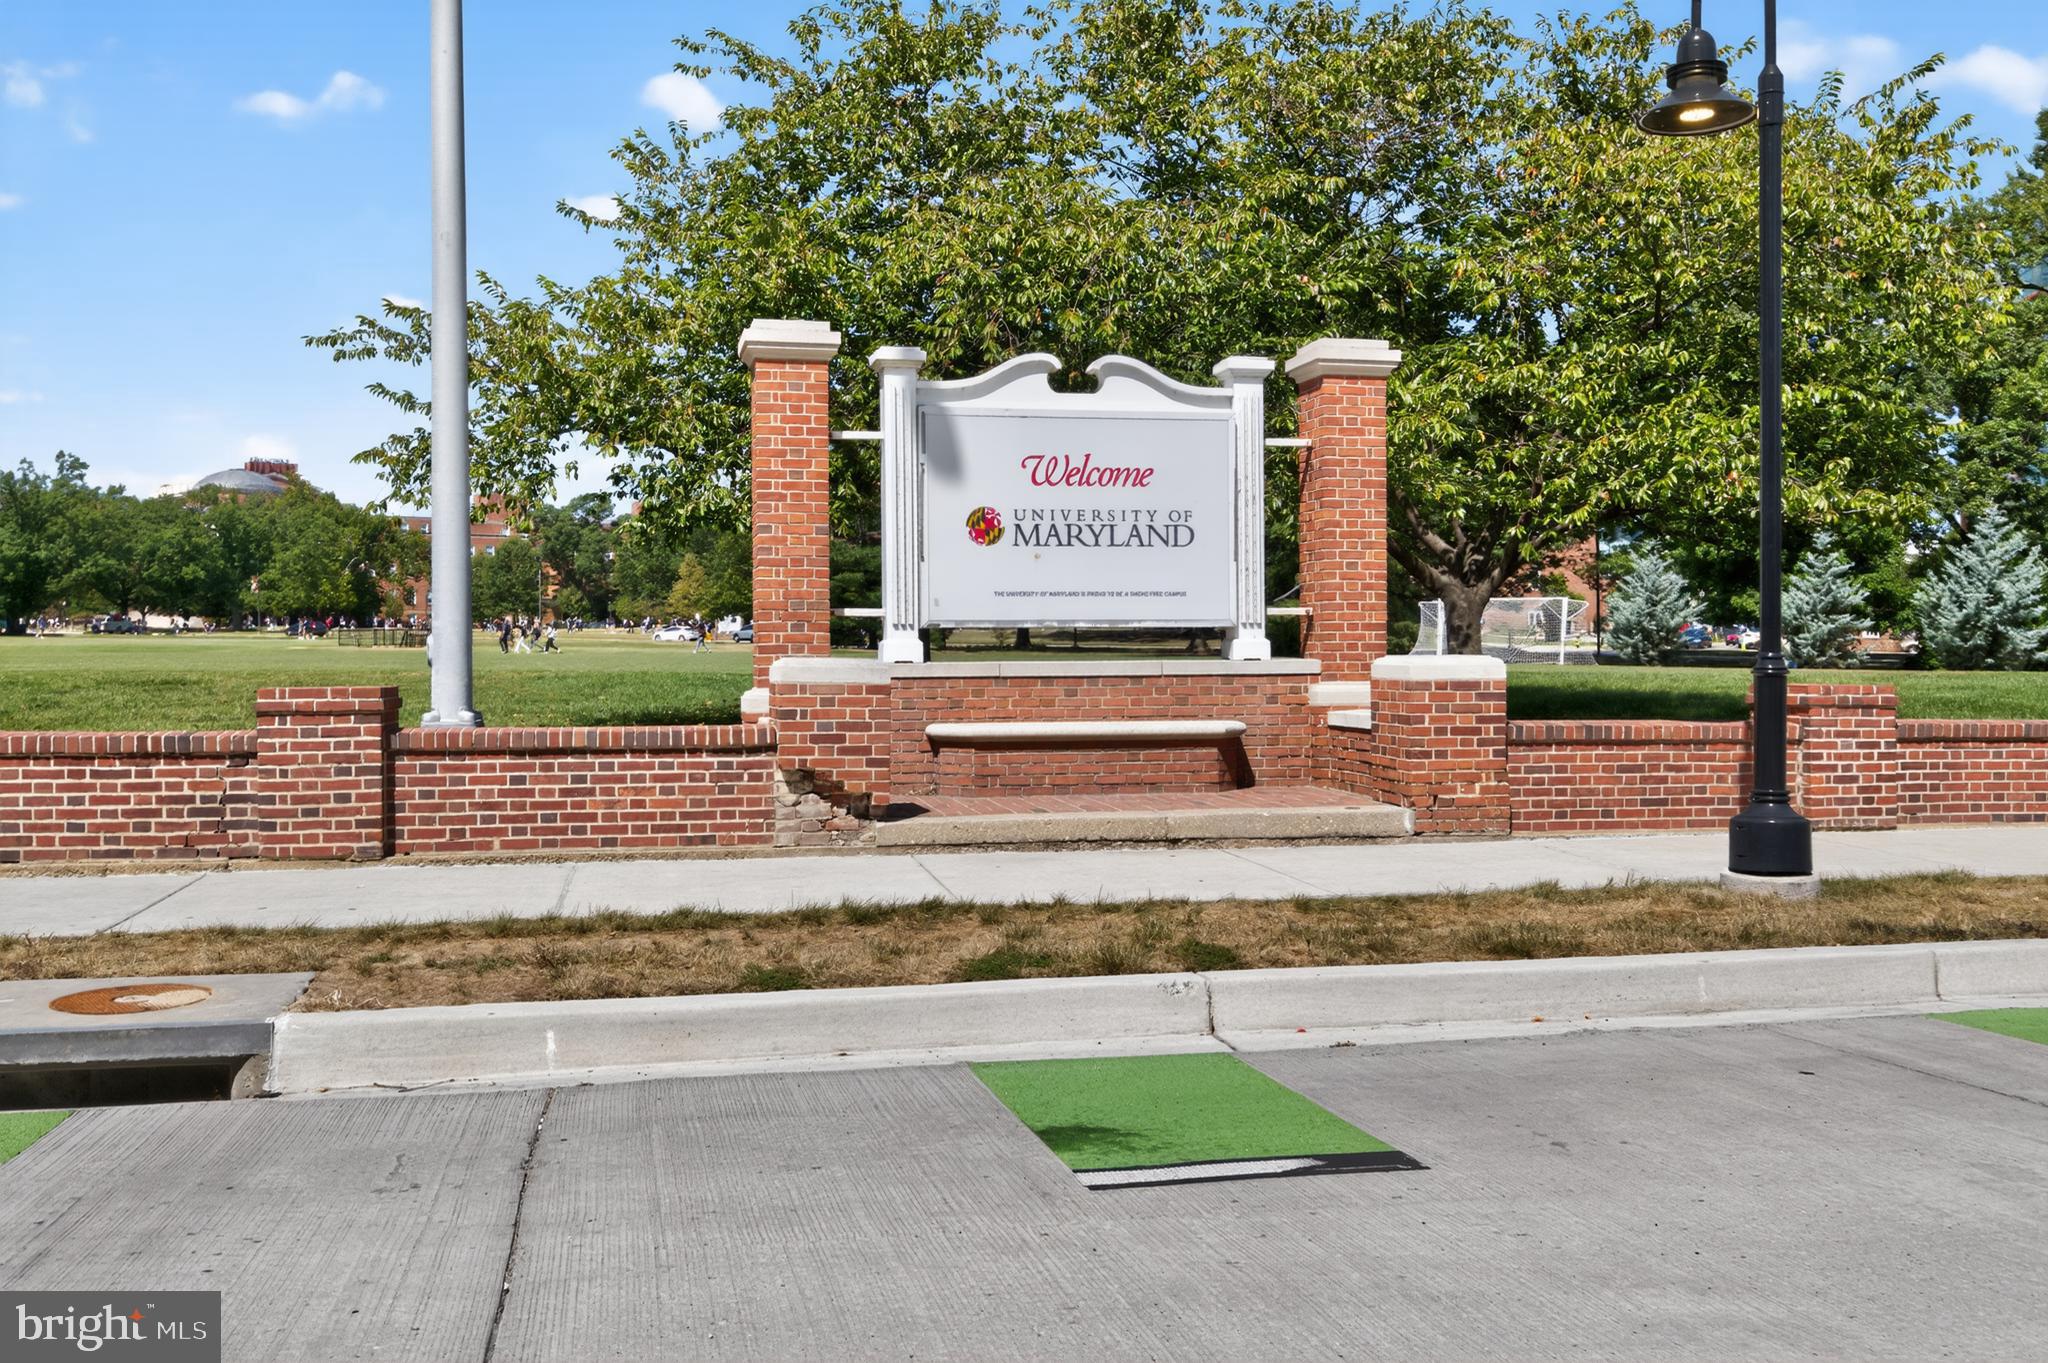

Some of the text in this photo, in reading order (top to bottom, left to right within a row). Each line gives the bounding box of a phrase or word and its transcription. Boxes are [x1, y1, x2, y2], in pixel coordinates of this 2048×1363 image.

[1020, 452, 1155, 488] Welcome
[1013, 508, 1193, 523] UNIVERSITY OF
[1012, 523, 1195, 548] MARYLAND
[994, 590, 1005, 598] THE
